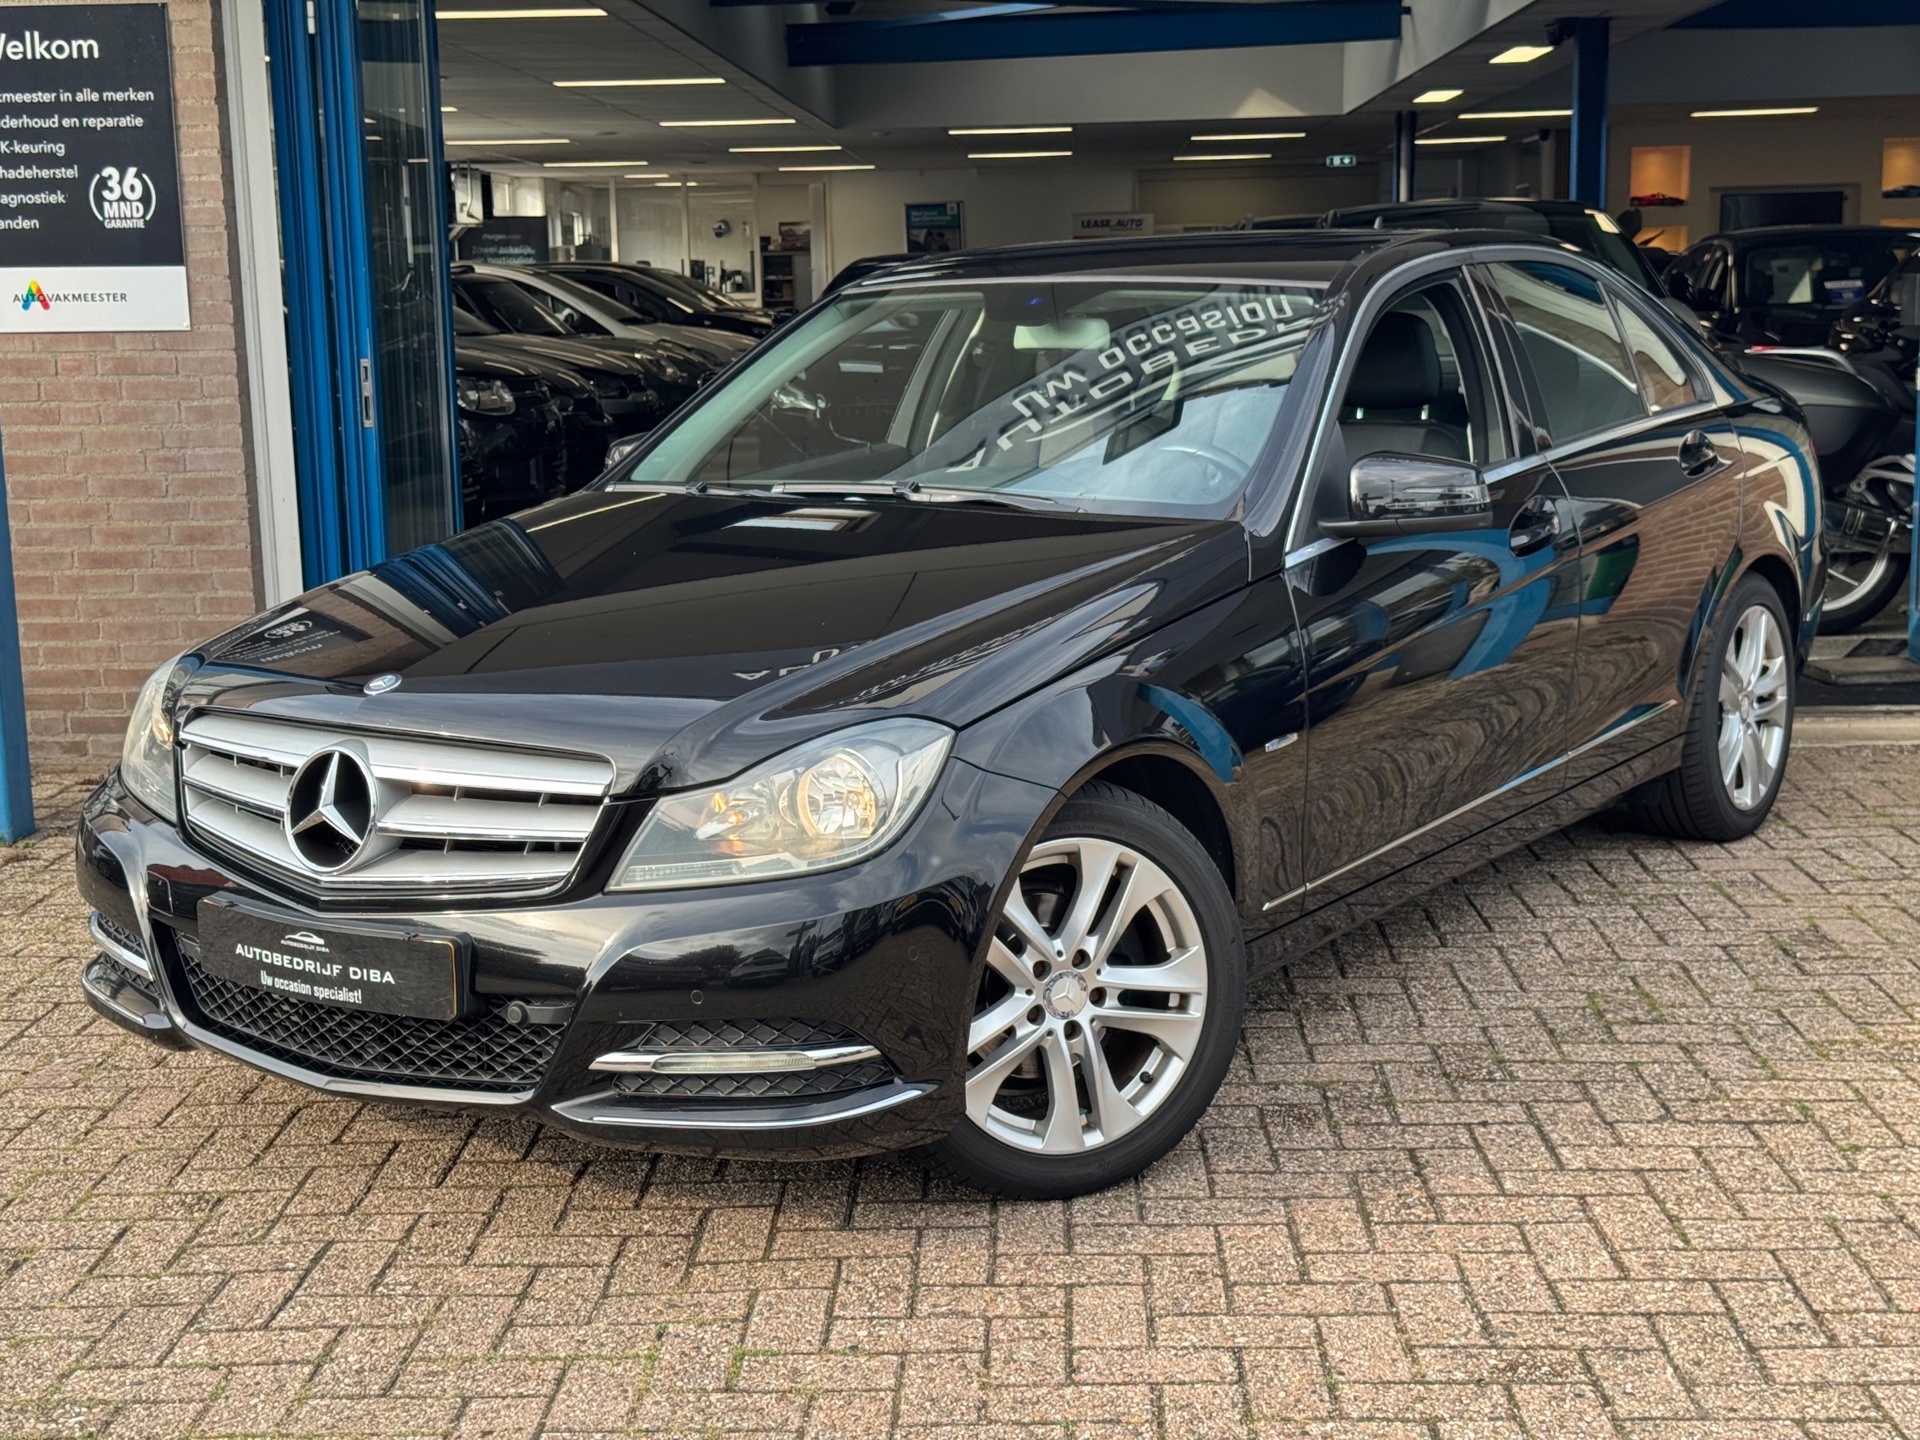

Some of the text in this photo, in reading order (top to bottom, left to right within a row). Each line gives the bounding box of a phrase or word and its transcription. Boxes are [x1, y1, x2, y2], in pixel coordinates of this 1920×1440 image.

[0, 88, 154, 103] meester in alle merken
[62, 117, 79, 128] en
[83, 114, 144, 131] reparatie
[101, 166, 143, 201] 36
[103, 201, 144, 219] MND
[104, 219, 146, 229] GARANTIE
[12, 292, 128, 304] AUTOVAKMEESTER
[235, 943, 396, 985] AUTOBEDRIJF DIBA
[260, 970, 363, 1004] Uw occasion specialist!
